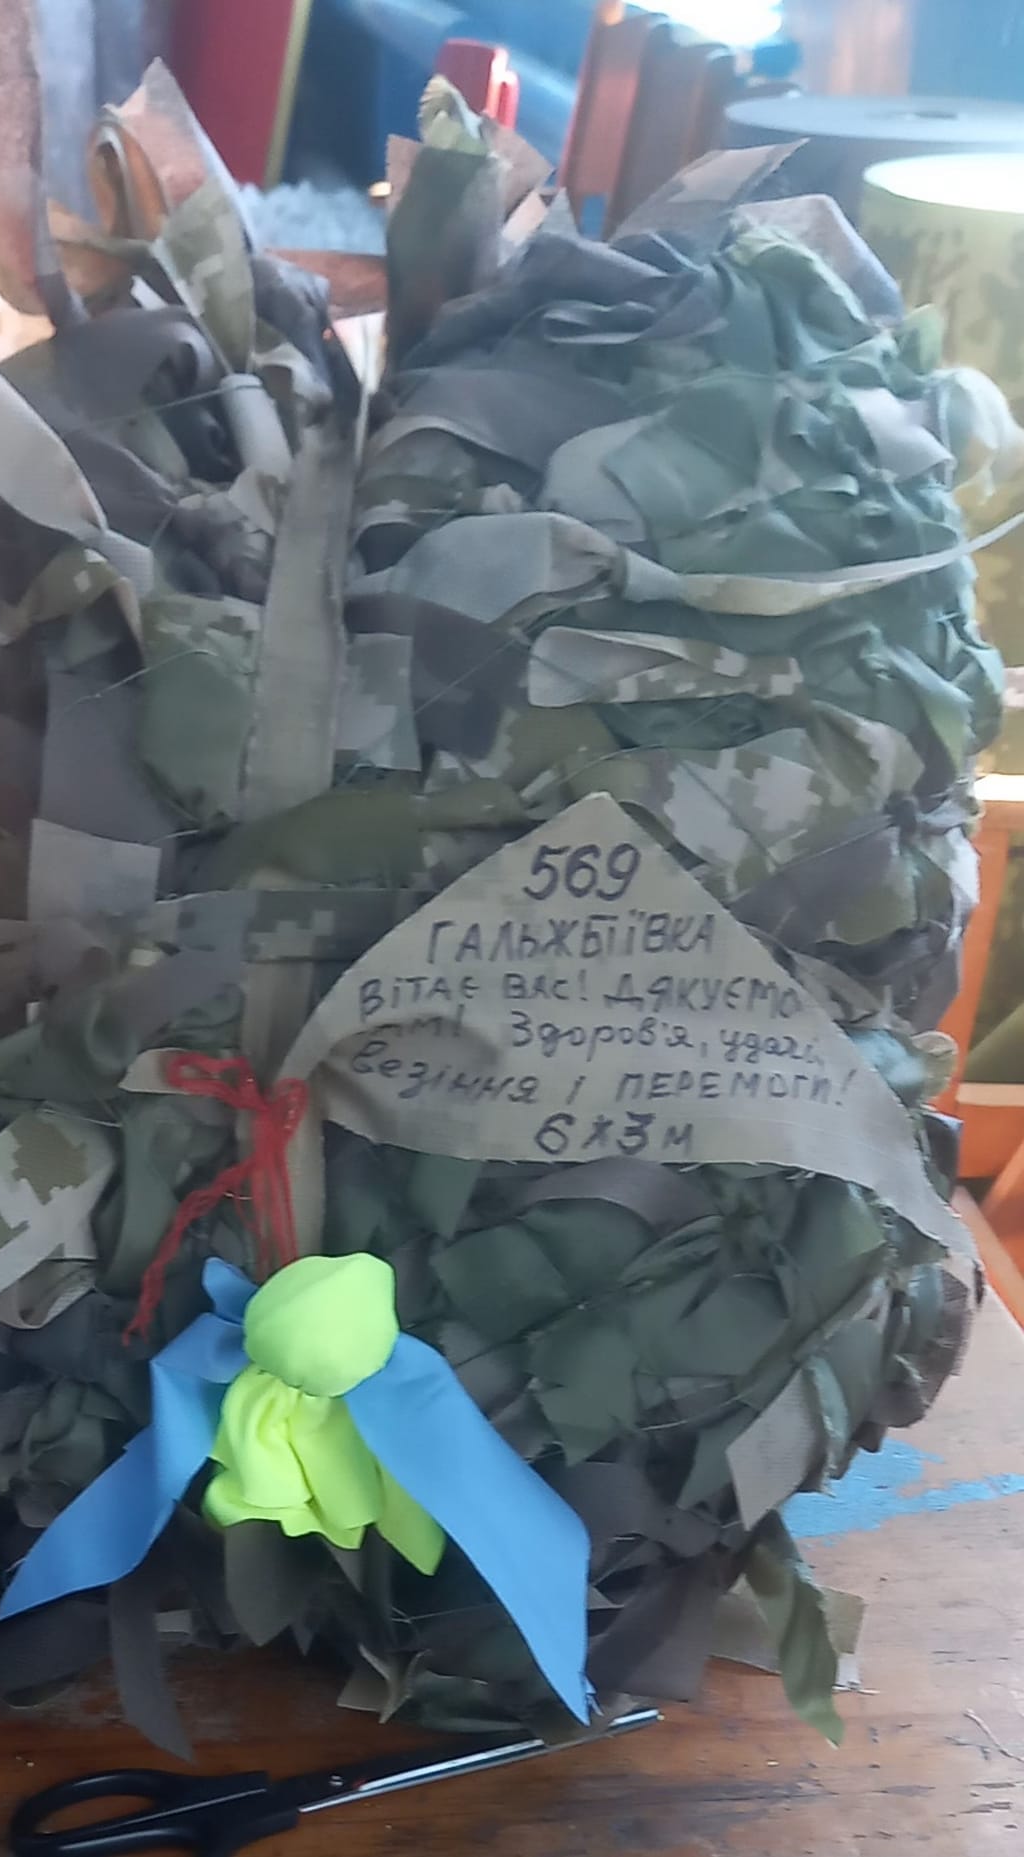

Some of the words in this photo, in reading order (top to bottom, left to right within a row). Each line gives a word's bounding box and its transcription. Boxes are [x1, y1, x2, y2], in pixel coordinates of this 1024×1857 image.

[523, 844, 642, 901] 569
[502, 968, 589, 1002] ВАС!
[602, 972, 804, 1019] ДЯКУЄМО
[350, 1040, 541, 1105] везіння
[614, 1068, 858, 1107] ПЕРЕМОГИ!
